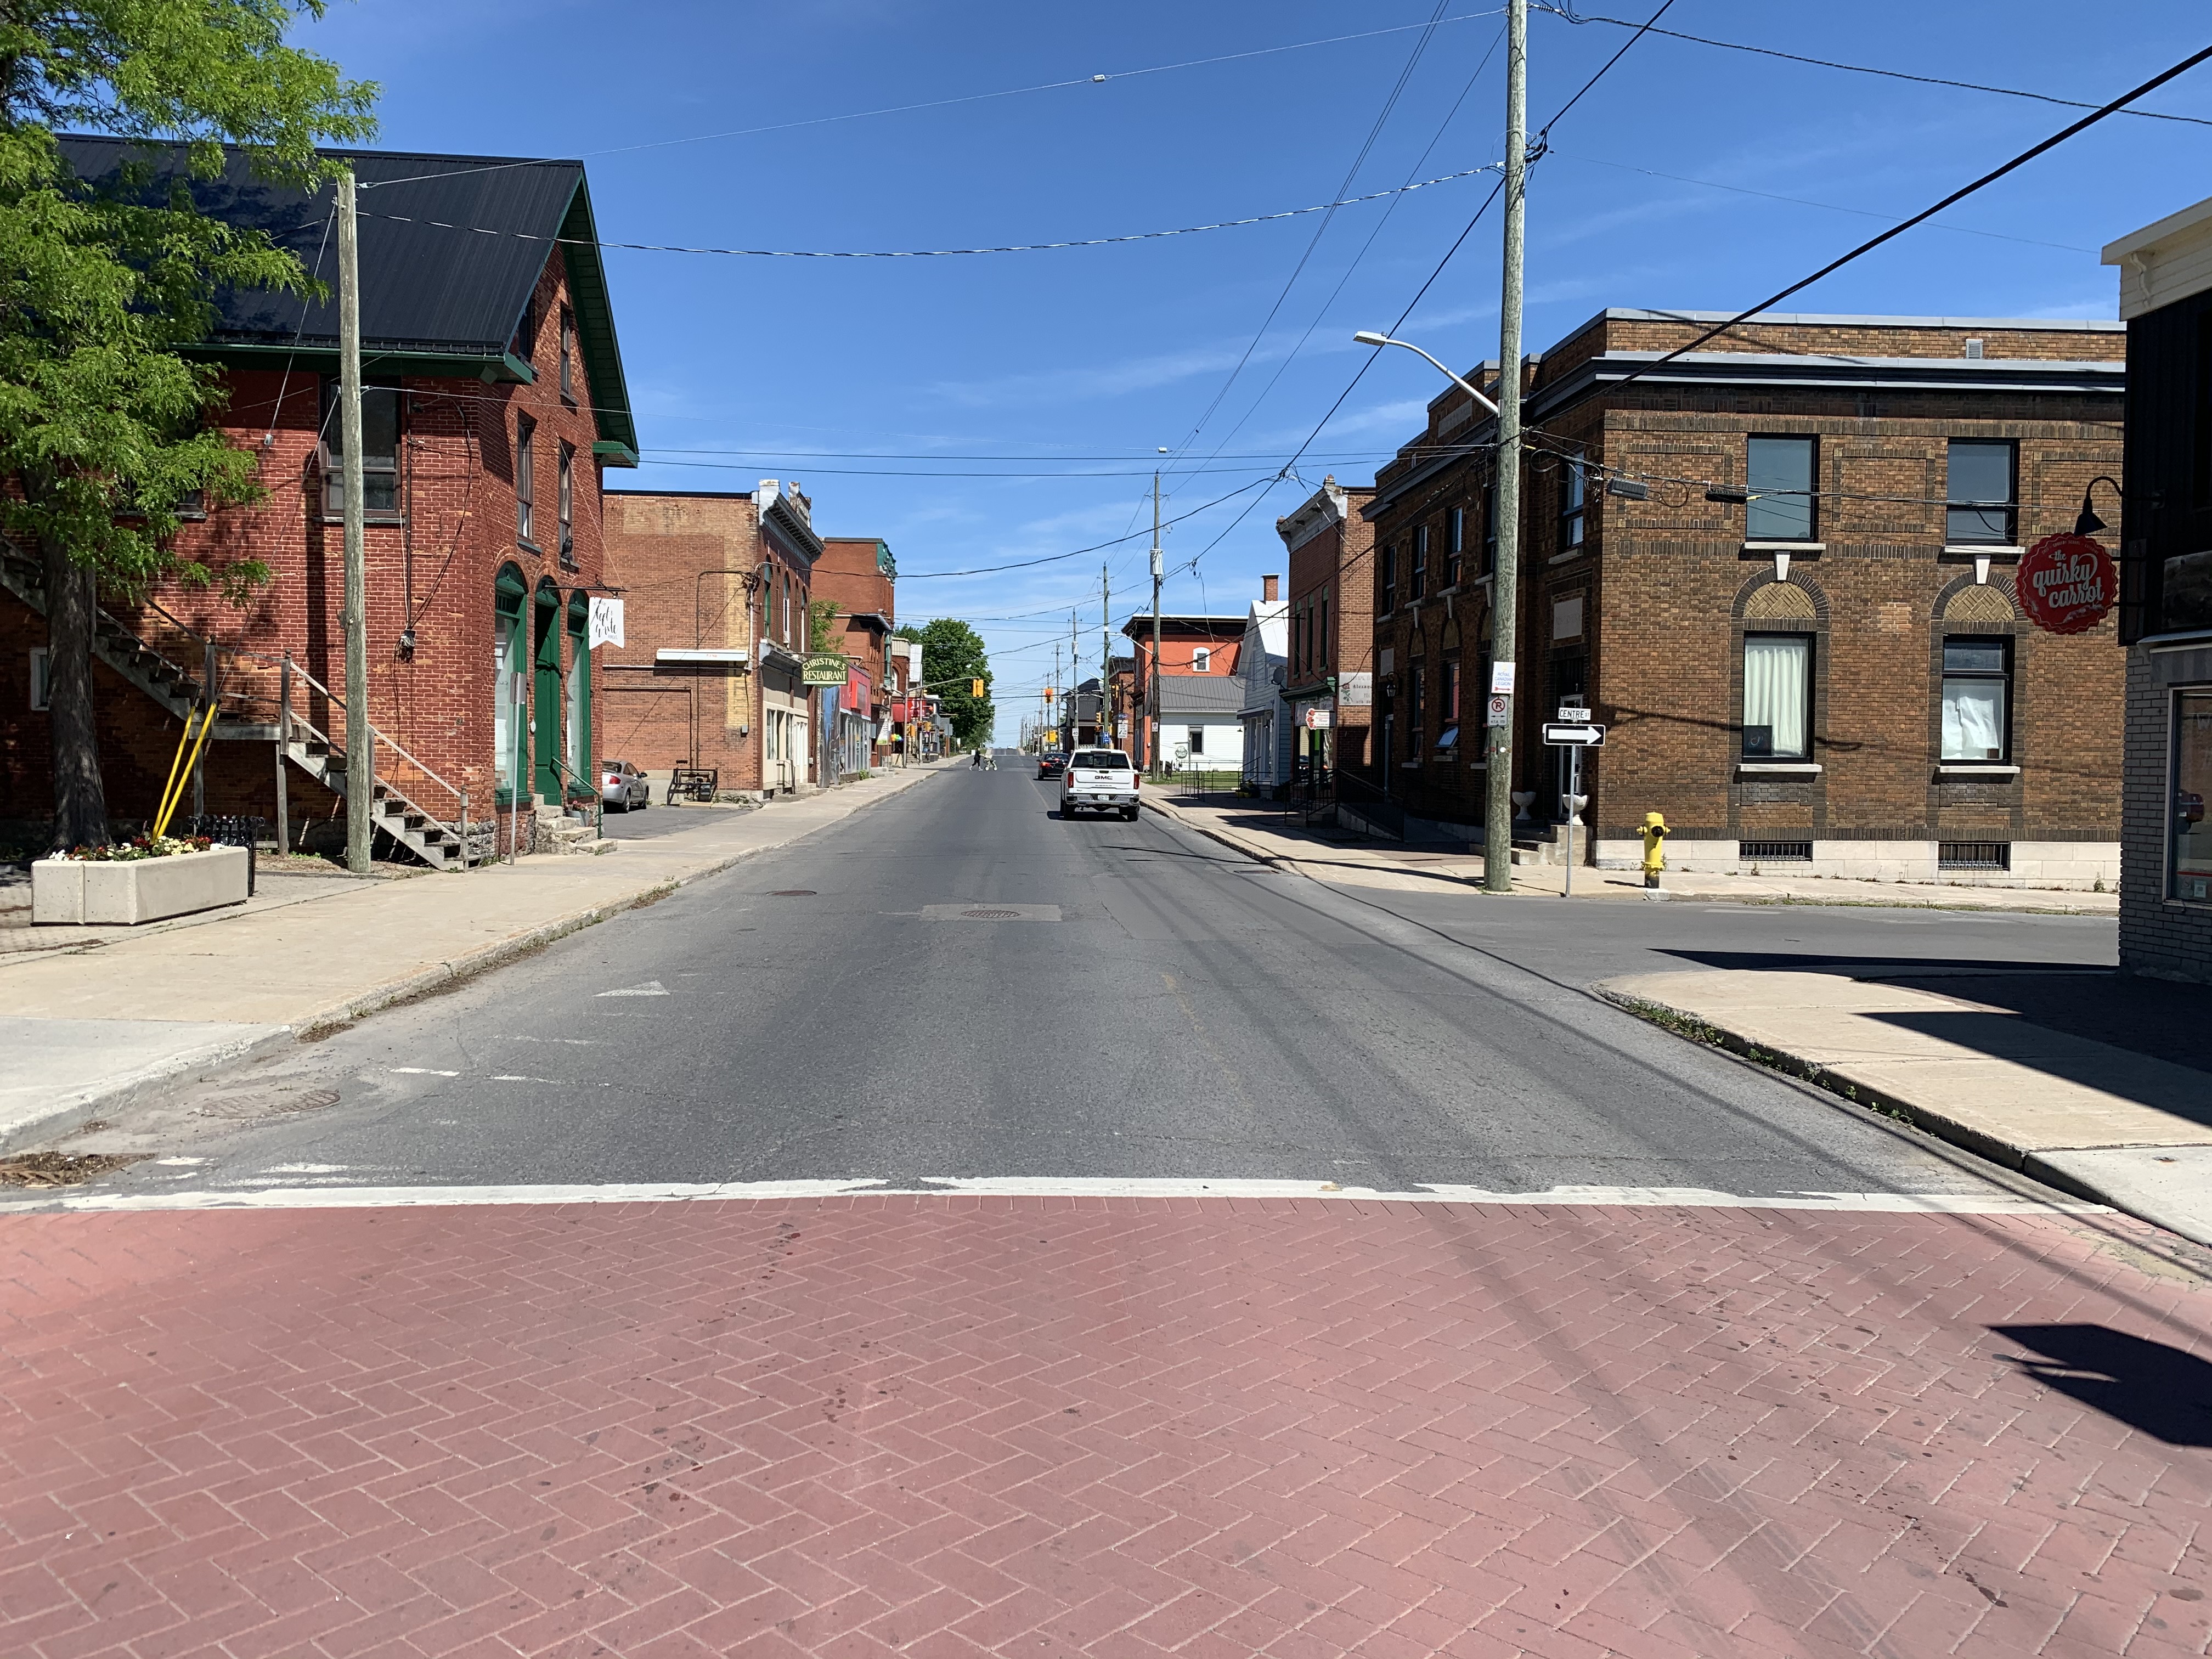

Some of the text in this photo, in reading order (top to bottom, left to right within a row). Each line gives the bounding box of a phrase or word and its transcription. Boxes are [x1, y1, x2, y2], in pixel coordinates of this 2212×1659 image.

[2049, 549, 2067, 561] the
[2033, 553, 2098, 597] quirky
[2049, 577, 2104, 608] carrot
[803, 670, 847, 681] RESTAURANT
